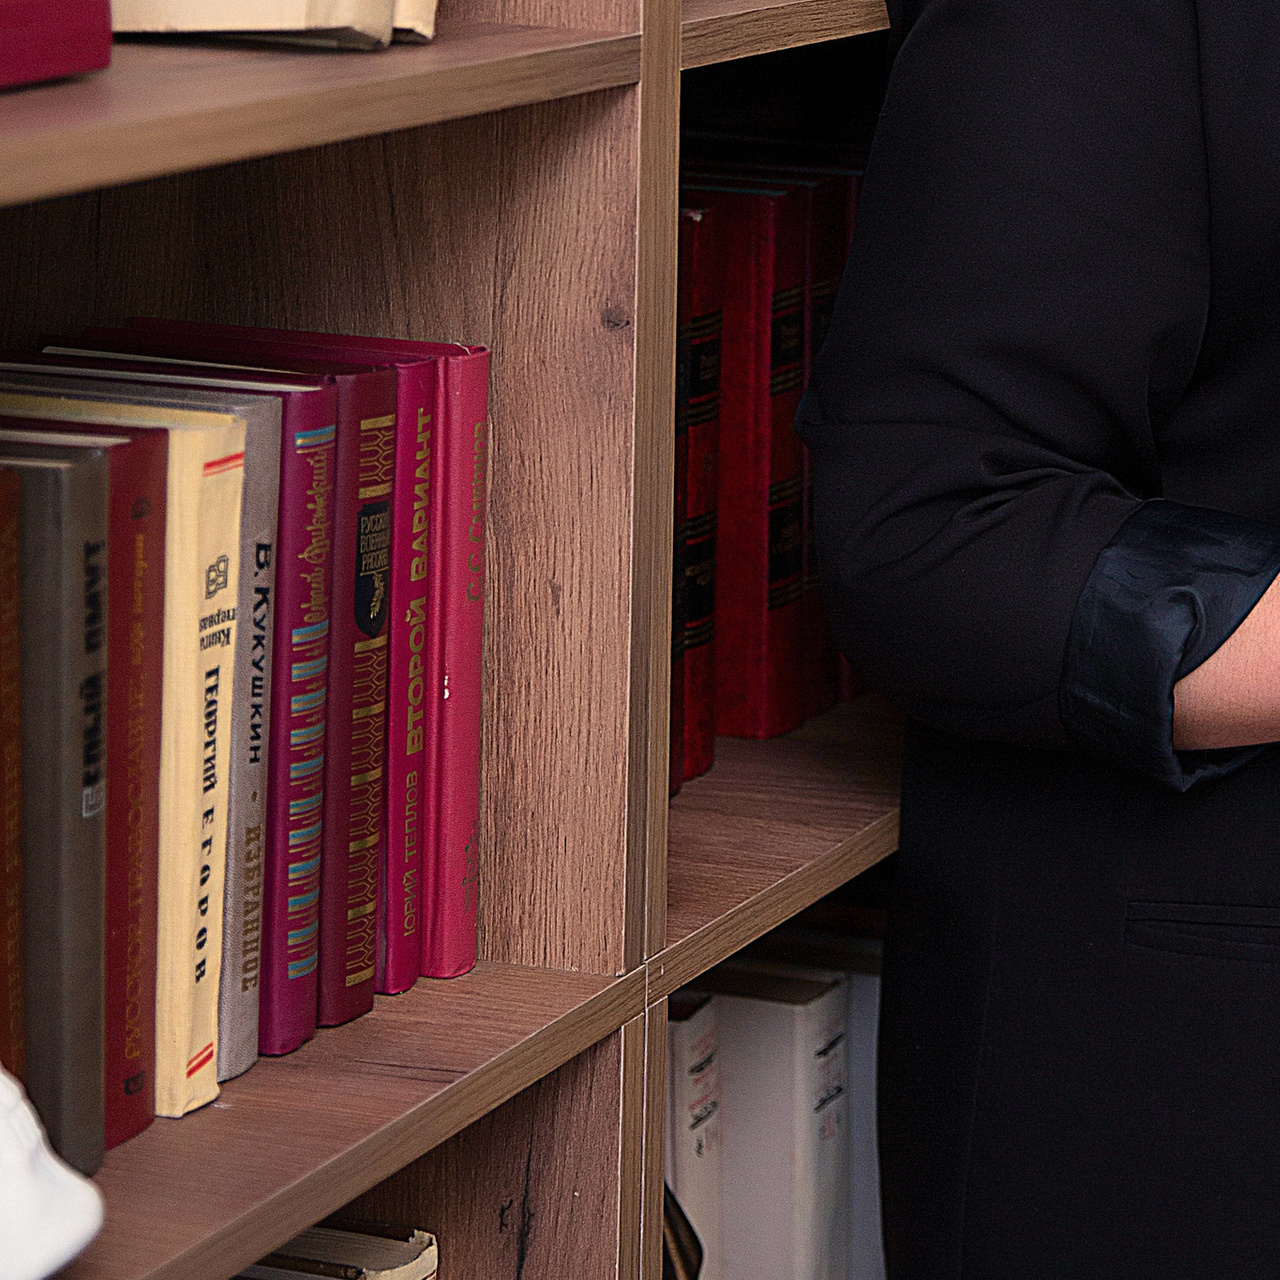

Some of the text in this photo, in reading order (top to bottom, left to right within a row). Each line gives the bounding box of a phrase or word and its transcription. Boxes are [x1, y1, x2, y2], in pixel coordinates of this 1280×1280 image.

[254, 543, 272, 577] В.
[404, 407, 431, 756] ВТОРОЙ ВАРИАНТ
[195, 665, 220, 984] ГЕОРГИЙ ЕГОРОВ
[241, 824, 262, 993] ИЗБРАННОЕ
[402, 770, 418, 937] ЮРИЙ ТЕПЛОВ
